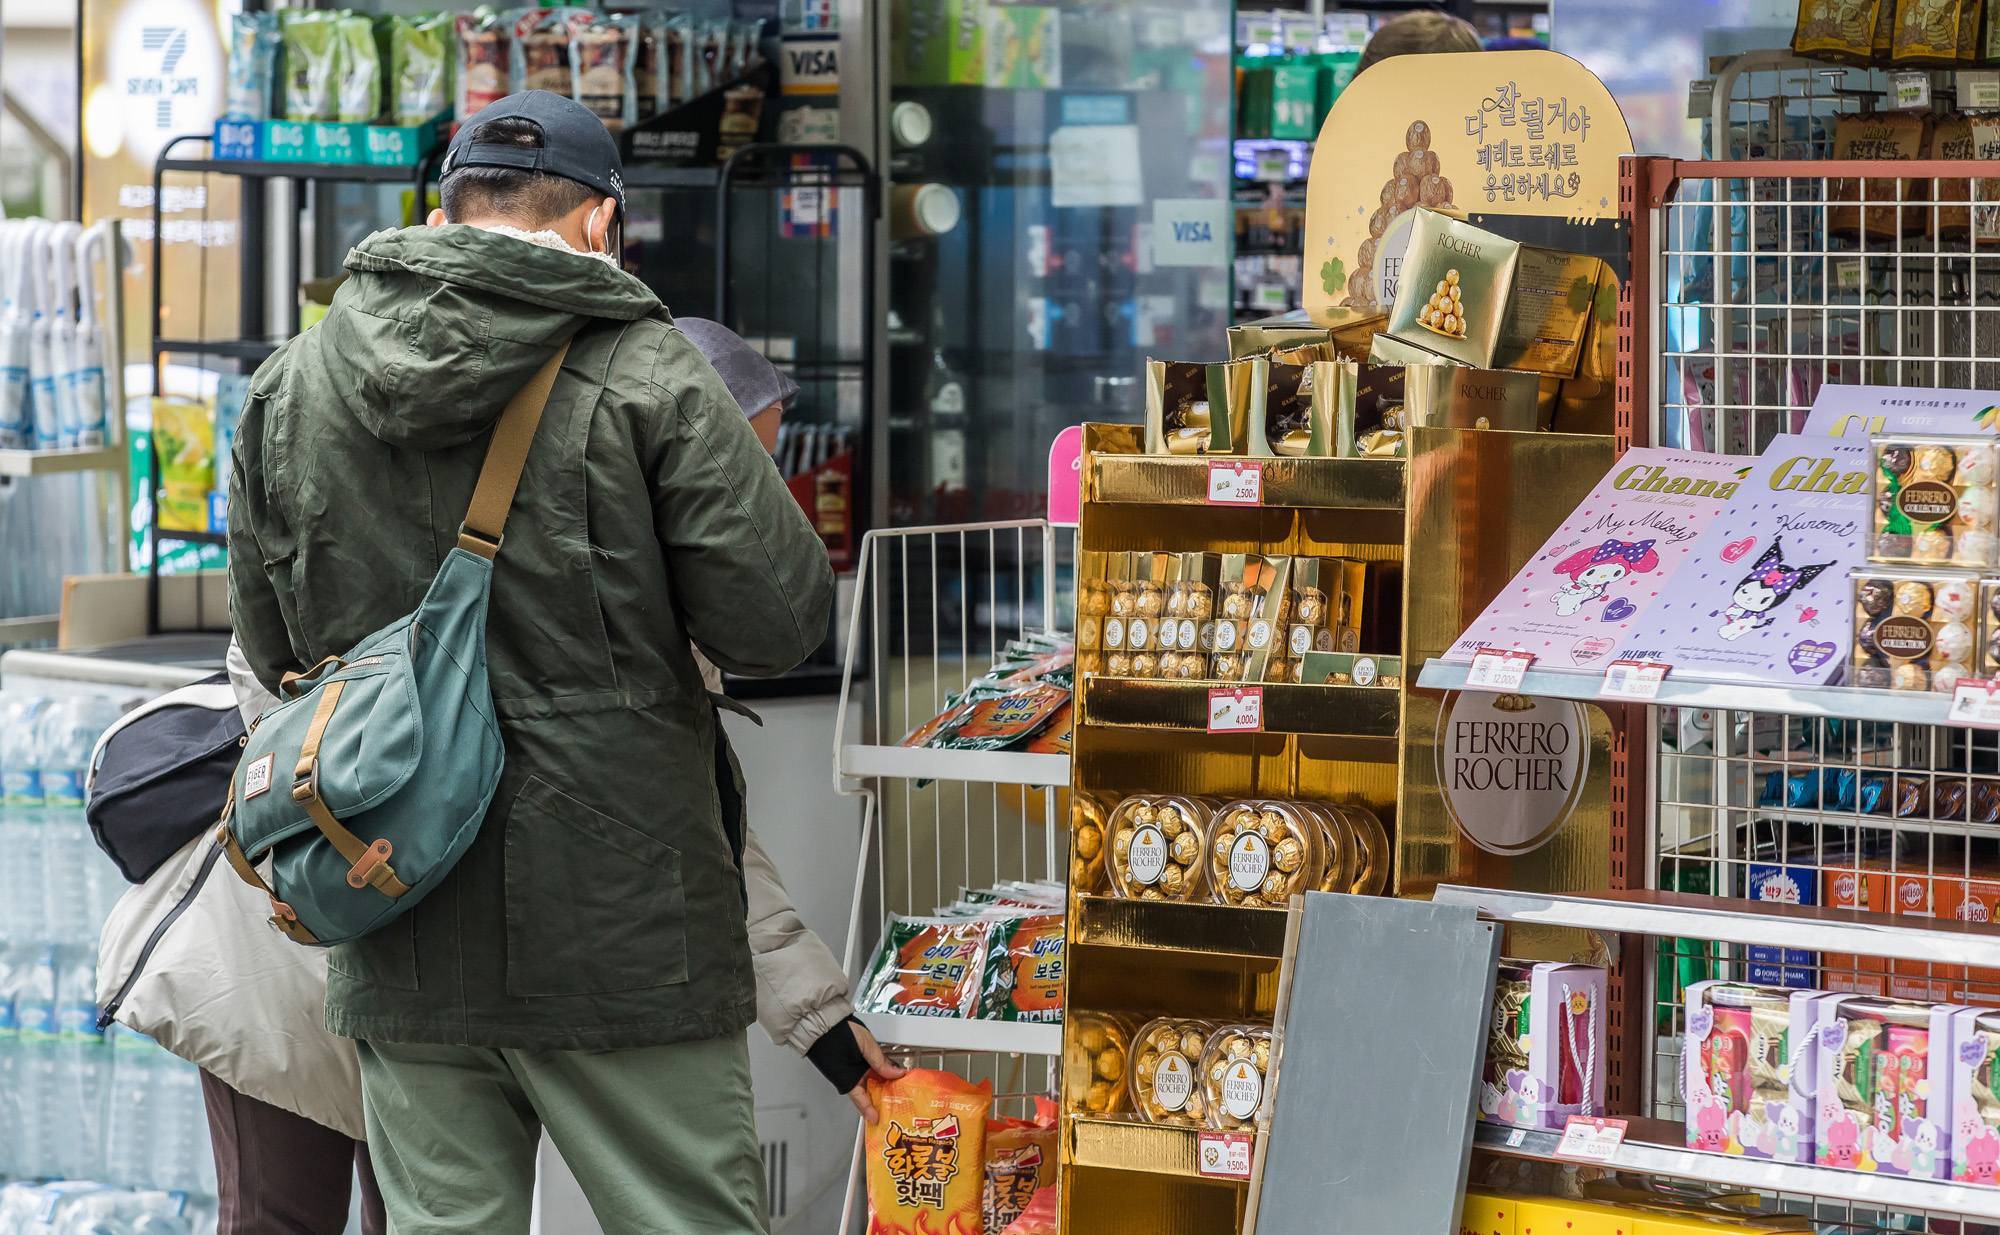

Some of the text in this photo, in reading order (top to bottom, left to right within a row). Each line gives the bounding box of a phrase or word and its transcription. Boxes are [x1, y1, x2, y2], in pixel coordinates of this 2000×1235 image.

[791, 51, 838, 75] VISA
[1477, 138, 1579, 172] 페레로 로쉐로
[1482, 172, 1567, 202] 응원하세요
[1172, 221, 1212, 243] VISA
[1437, 232, 1482, 260] ROCHER
[1461, 384, 1508, 401] ROCHER
[1901, 415, 1935, 426] LOTTE
[1613, 464, 1741, 500] Ghana
[1769, 456, 1869, 494] Gha
[1904, 490, 1951, 505] FERRERO
[1581, 509, 1698, 545] My Melody
[1773, 512, 1858, 537] Kuromi
[1881, 625, 1927, 639] FERRERO
[1455, 721, 1570, 755] FERRERO
[1454, 757, 1568, 791] ROCHER
[1132, 847, 1162, 858] FERRERO
[1132, 856, 1162, 867] ROCHER
[1233, 853, 1264, 864] FERRERO
[1233, 862, 1263, 874] ROCHER
[1495, 1007, 1505, 1035] Auer
[1756, 1033, 1765, 1064] Auer
[1157, 1073, 1188, 1084] FERRERO
[1157, 1082, 1188, 1094] ROCHER
[1226, 1080, 1257, 1092] FERRERO
[1226, 1089, 1256, 1102] ROCHER
[896, 1180, 942, 1208] 핫팩
